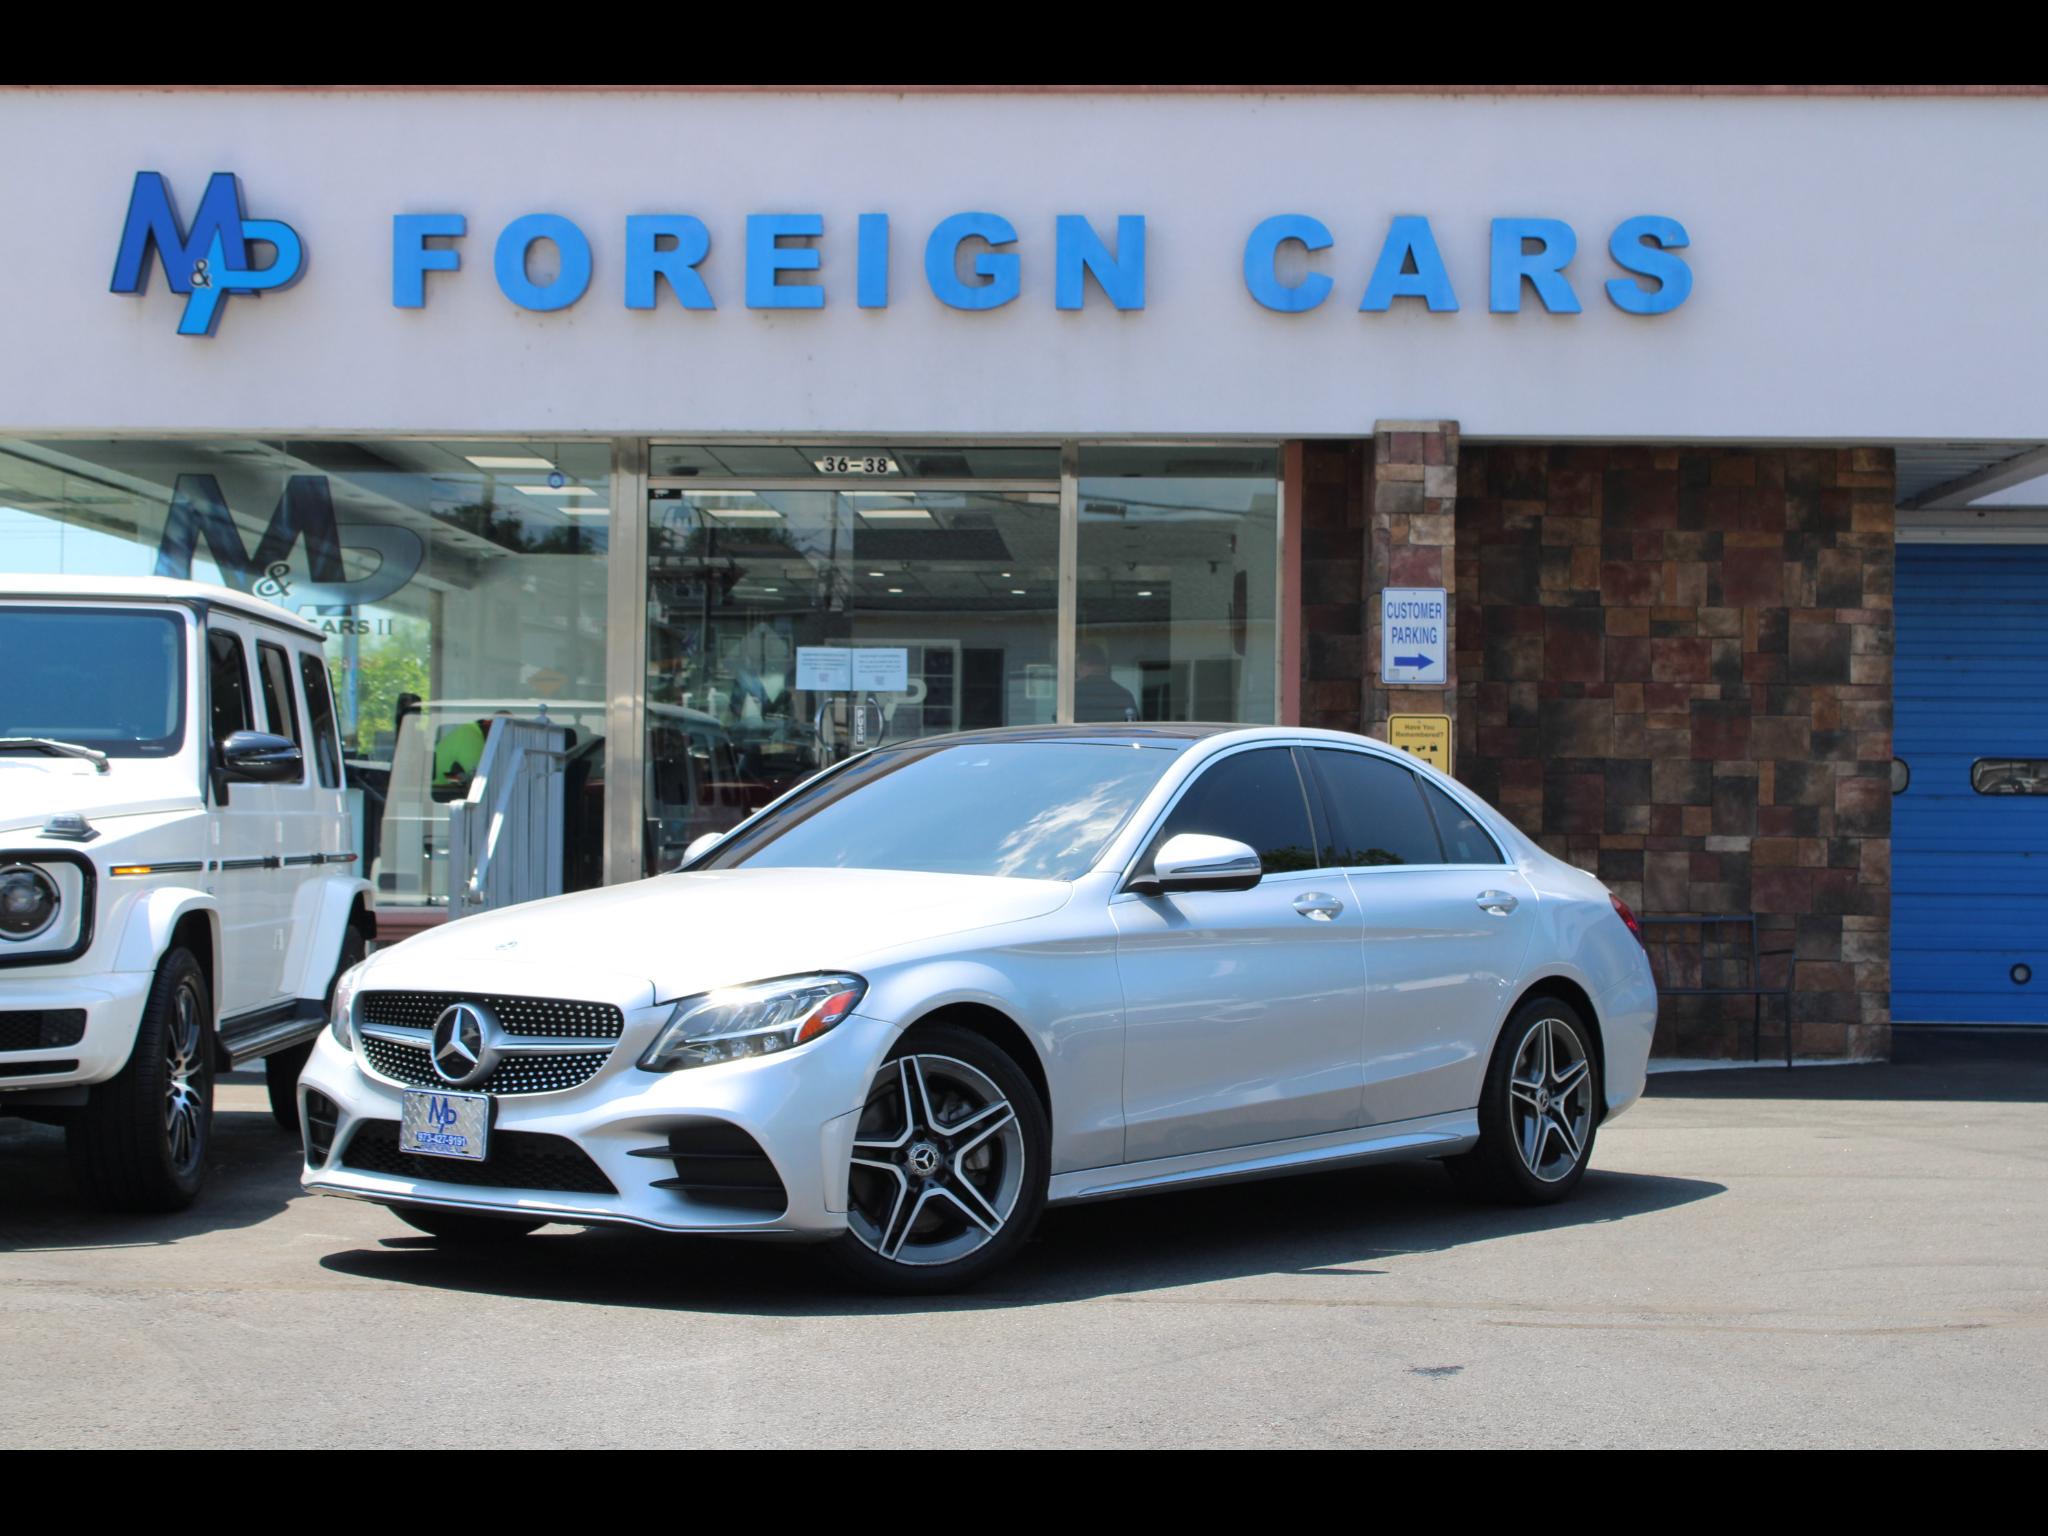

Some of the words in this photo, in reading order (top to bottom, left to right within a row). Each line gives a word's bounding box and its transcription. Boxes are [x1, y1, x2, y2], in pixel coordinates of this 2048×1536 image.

[392, 211, 1147, 311] FOREIGN
[1243, 212, 1696, 315] CARS
[824, 456, 888, 474] 36-38
[1386, 602, 1442, 620] CUSTOMER
[306, 618, 370, 635] ARS
[1391, 627, 1437, 645] PARKING
[856, 708, 866, 743] PUSH
[1404, 723, 1421, 731] Have
[1423, 723, 1436, 731] You
[1395, 731, 1444, 739] Remembered?
